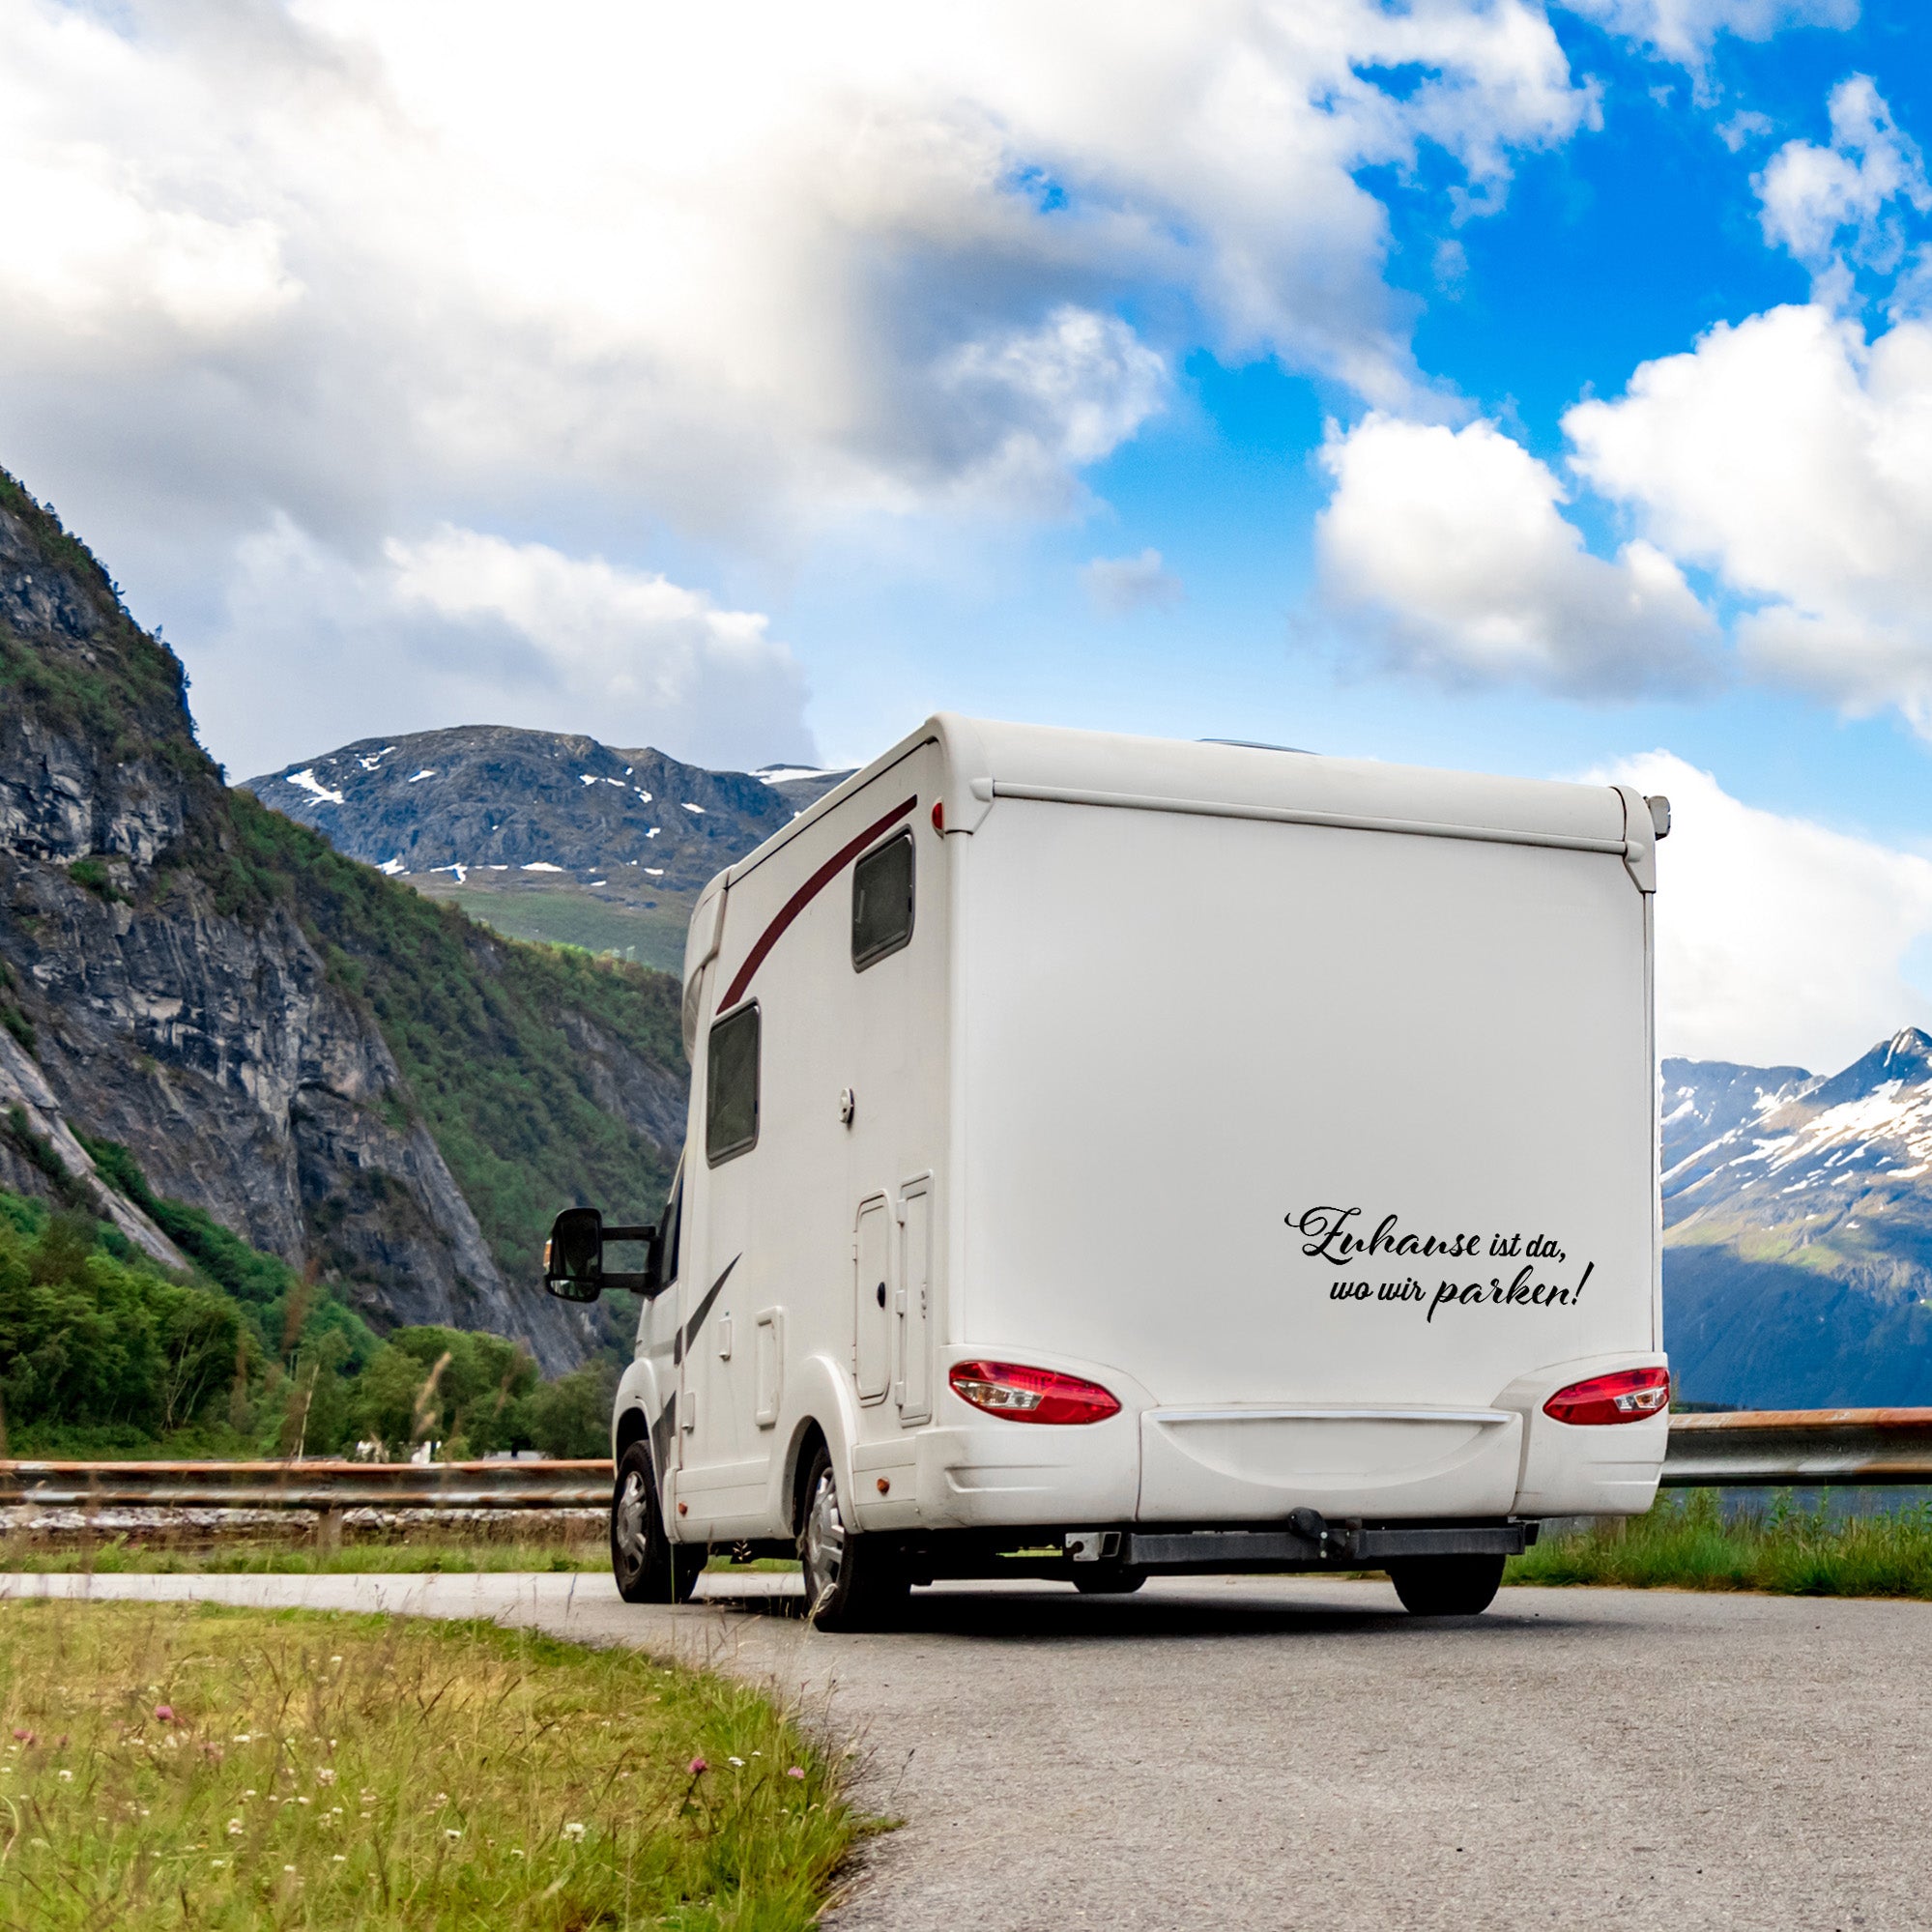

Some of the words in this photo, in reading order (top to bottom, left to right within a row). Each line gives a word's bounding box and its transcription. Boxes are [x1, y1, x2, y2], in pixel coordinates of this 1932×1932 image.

[1283, 1205, 1481, 1265] Zuhause
[1488, 1232, 1522, 1257] ist
[1525, 1233, 1567, 1262] da,
[1329, 1281, 1374, 1301] wo
[1377, 1277, 1427, 1301] wir
[1427, 1260, 1595, 1324] parken!
